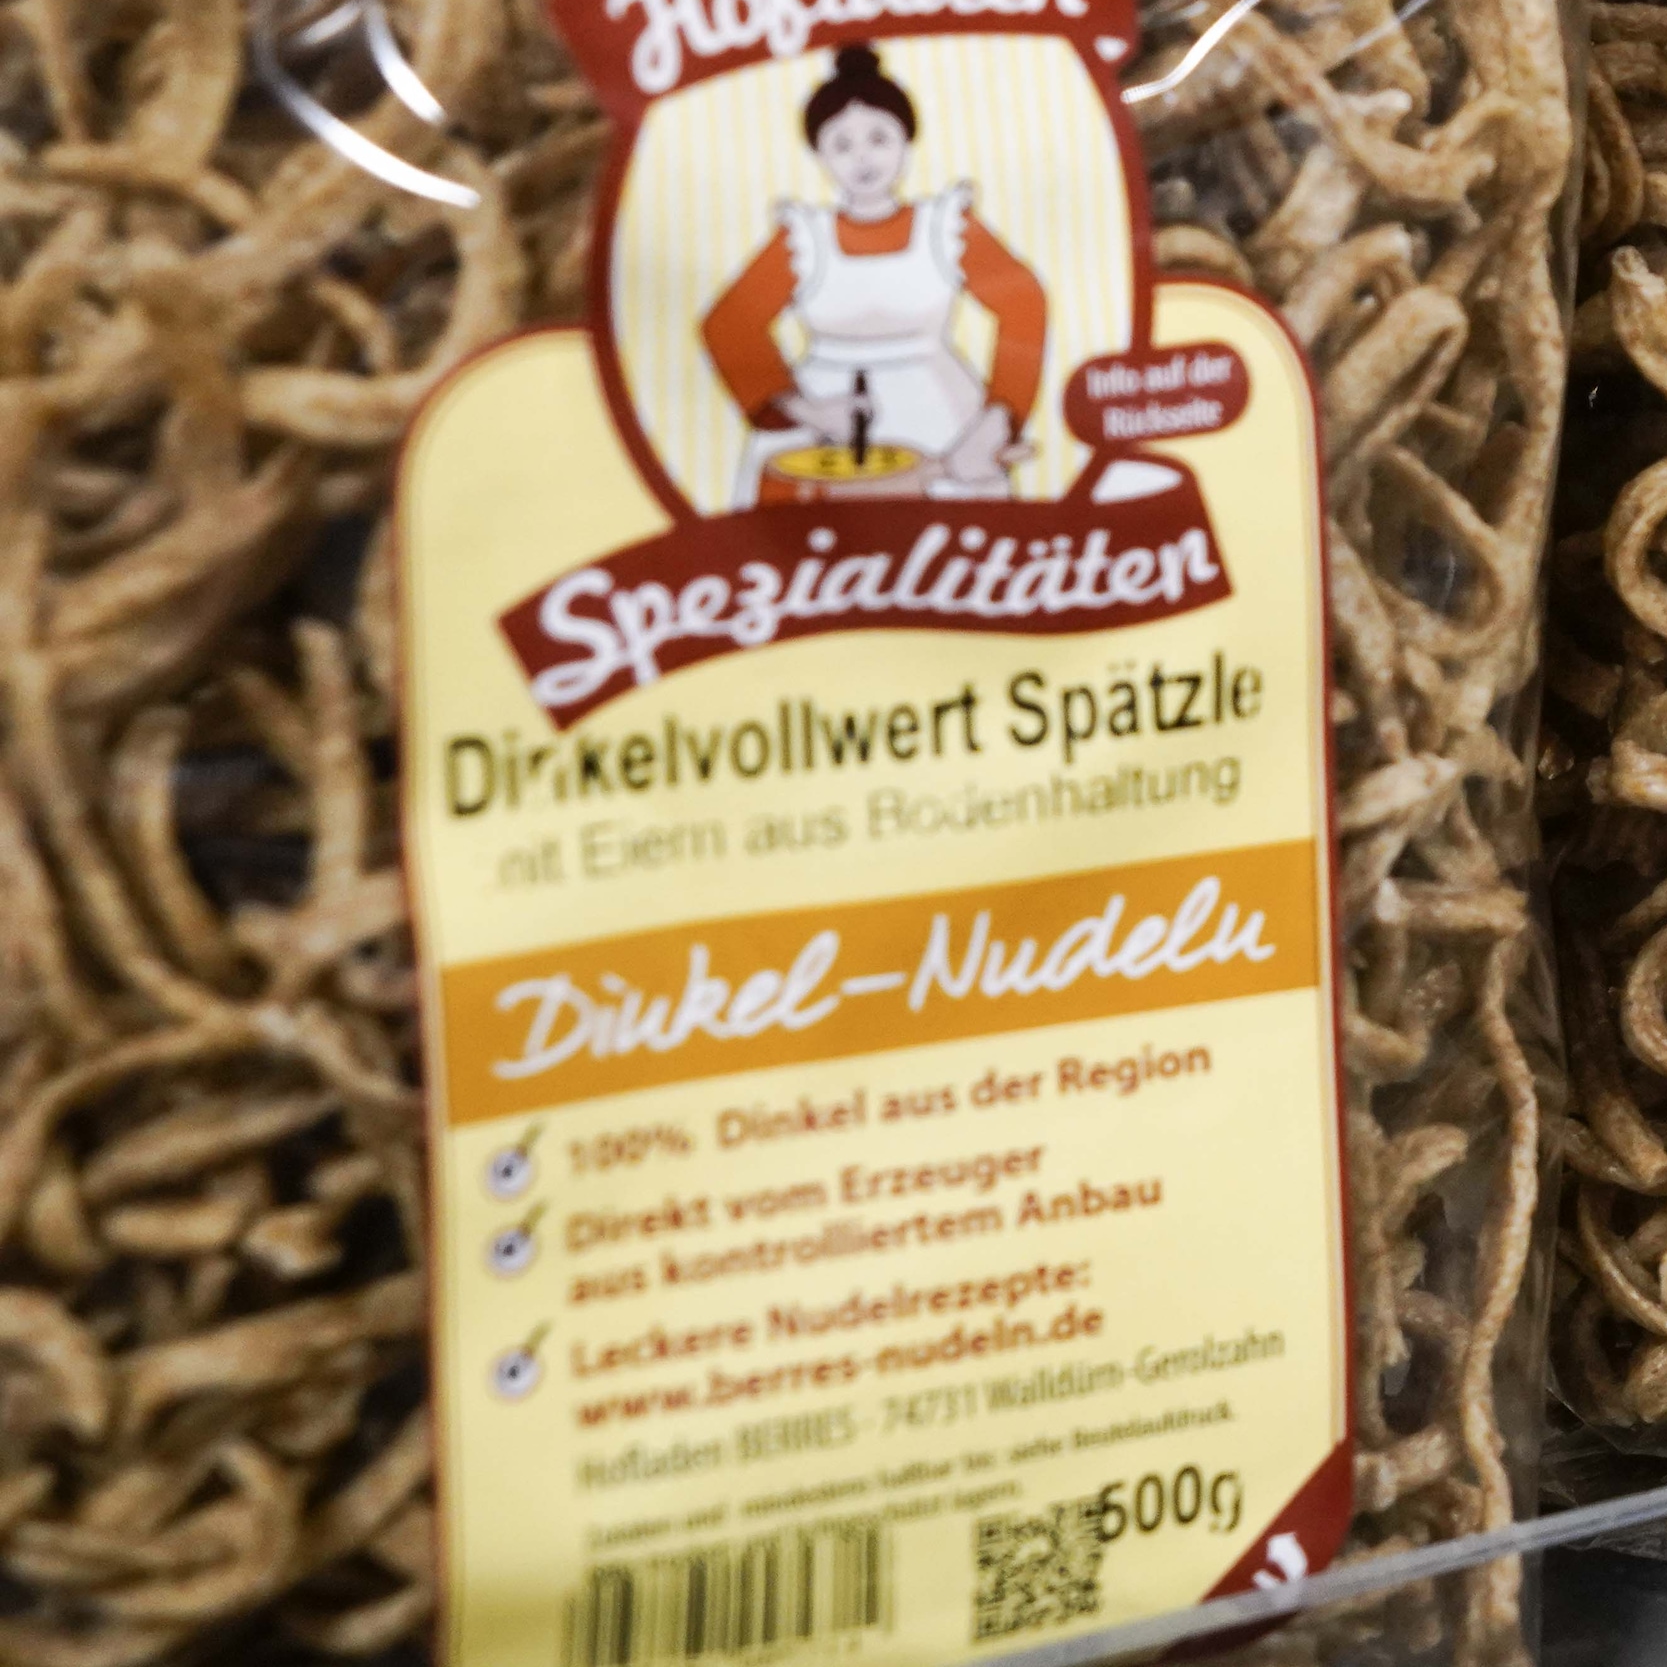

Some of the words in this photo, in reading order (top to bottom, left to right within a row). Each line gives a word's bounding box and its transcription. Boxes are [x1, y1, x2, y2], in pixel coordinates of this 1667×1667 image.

[530, 525, 1219, 707] Spezialitäten
[1008, 649, 1263, 764] Spätzle
[743, 802, 849, 858] aus
[491, 875, 1275, 1081] Dinkel-Nudeln
[716, 1087, 866, 1150] Dinkel
[880, 1083, 956, 1123] aus
[969, 1070, 1043, 1108] der
[1057, 1041, 1212, 1095] Region
[564, 1195, 711, 1254] Direkt
[725, 1180, 828, 1220] vom
[838, 1144, 1045, 1204] Erzeuger
[568, 1267, 647, 1306] aus
[659, 1204, 1003, 1284] kontrolliertem
[1017, 1176, 1163, 1227] Anbau
[568, 1322, 753, 1379] Leckere
[1095, 1464, 1246, 1546] 500g
